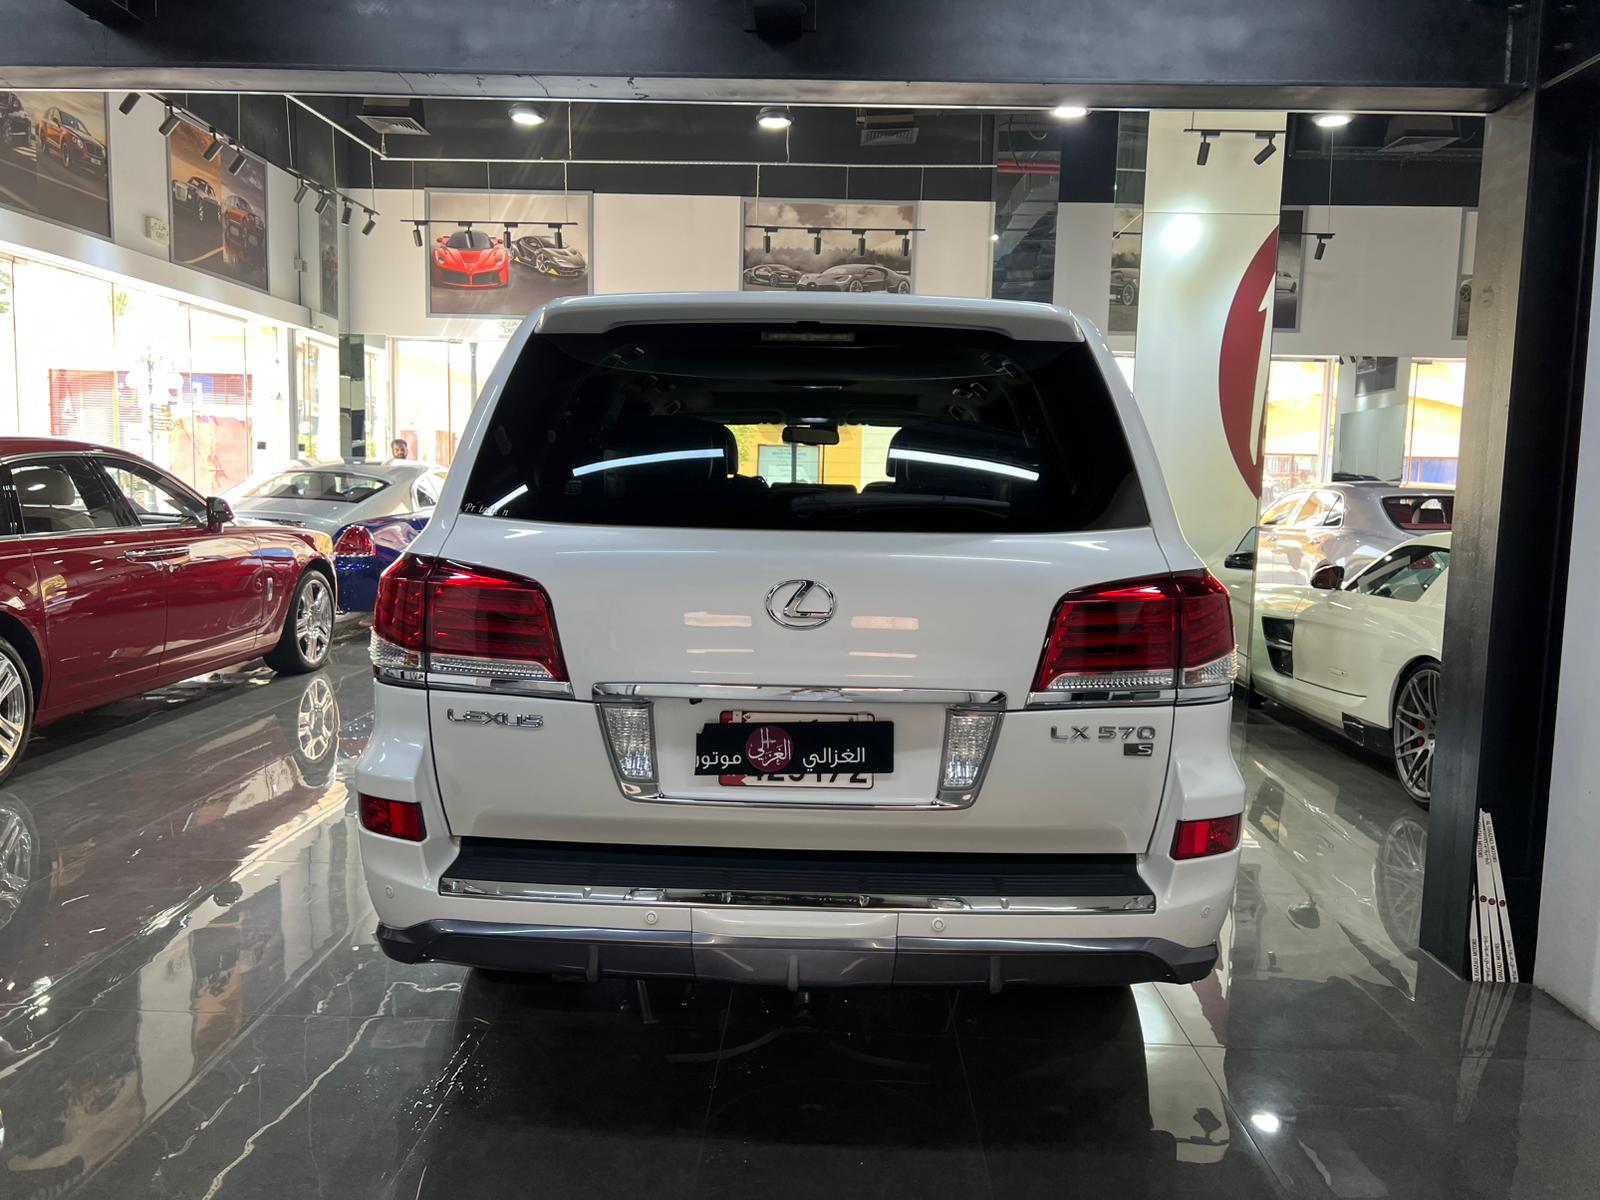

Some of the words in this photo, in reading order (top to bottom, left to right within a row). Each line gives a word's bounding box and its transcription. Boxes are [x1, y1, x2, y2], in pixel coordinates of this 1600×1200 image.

[447, 708, 544, 728] LEXUS
[1050, 726, 1089, 740] LX
[1098, 726, 1156, 741] 570
[802, 747, 865, 772] الغزالي
